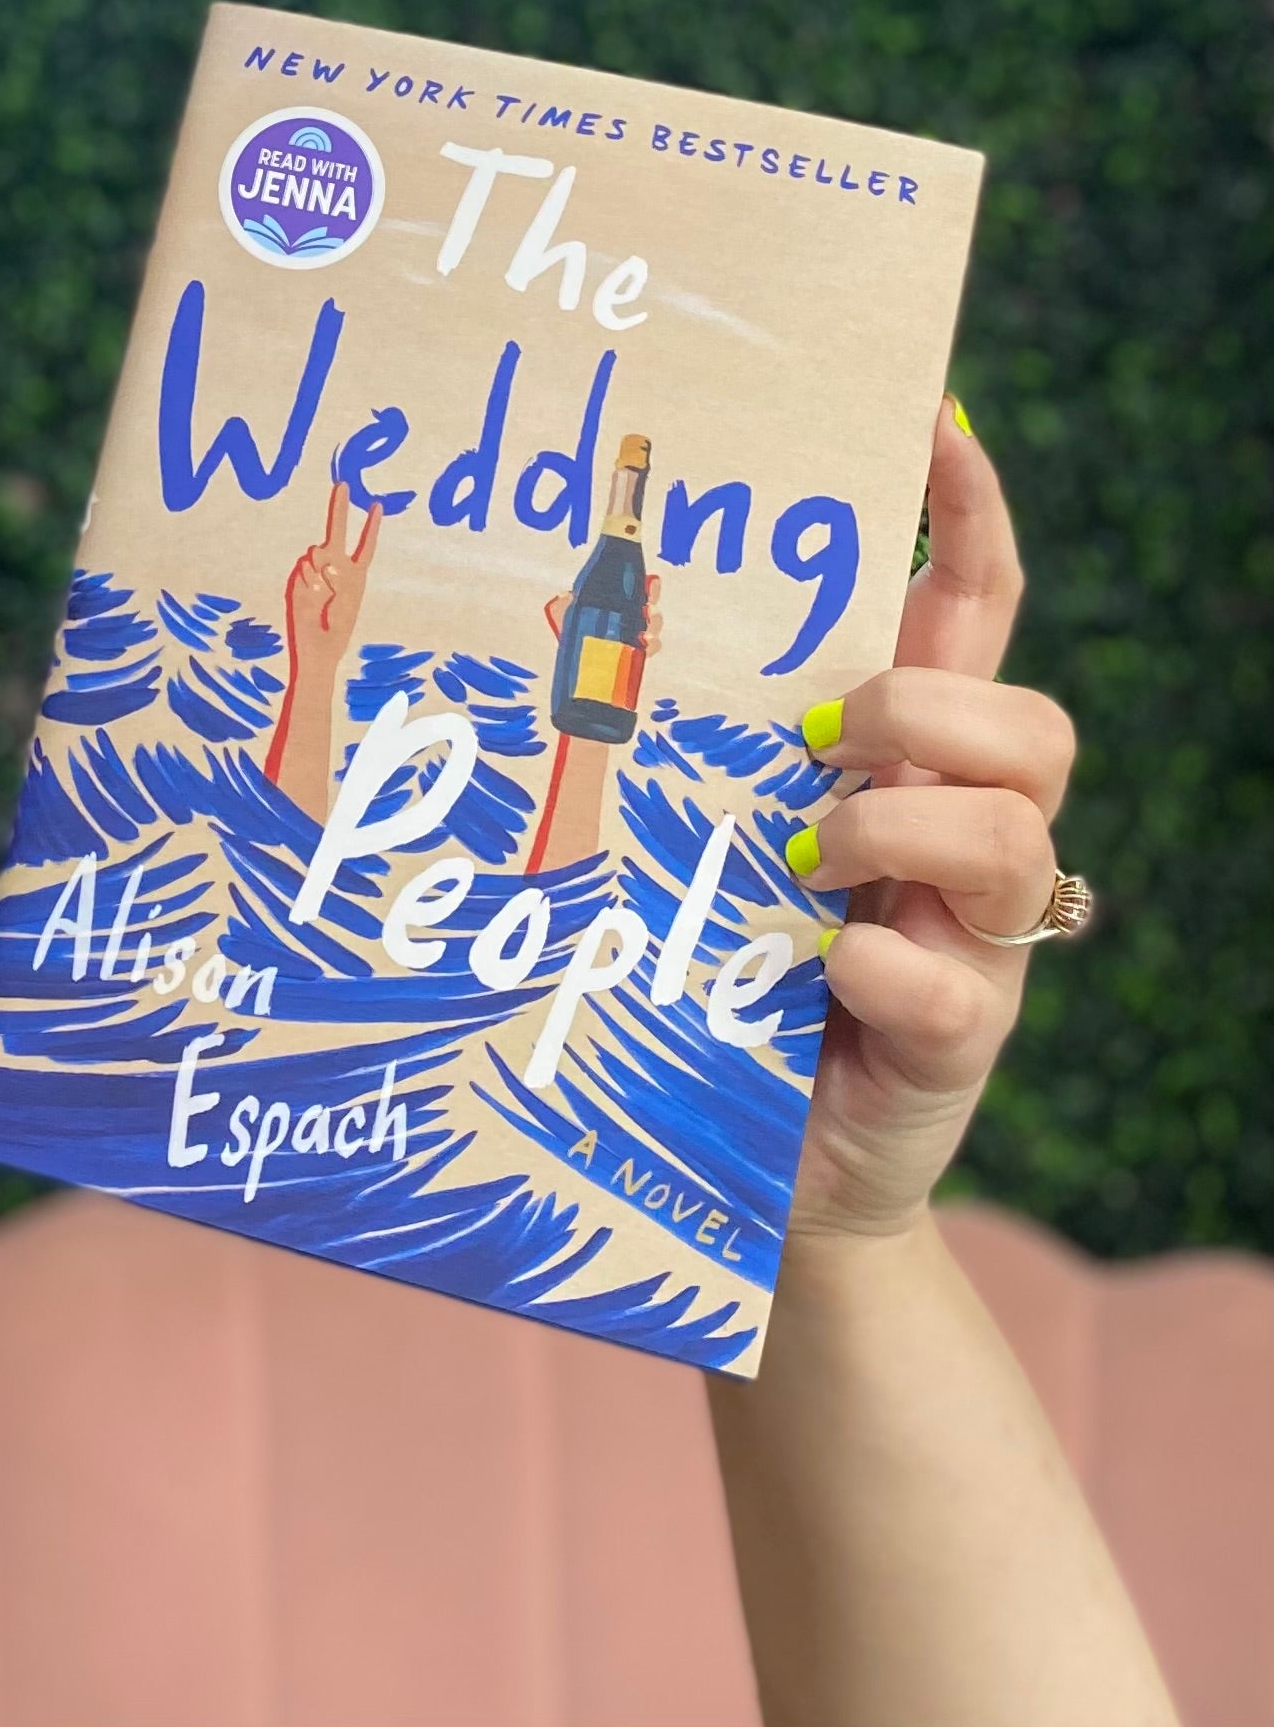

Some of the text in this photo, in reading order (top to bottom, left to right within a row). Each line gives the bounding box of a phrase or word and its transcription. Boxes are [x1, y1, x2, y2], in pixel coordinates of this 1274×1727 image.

[237, 168, 357, 221] JENNA
[244, 46, 919, 205] NEW YORK TIMES BESTSELLER
[258, 148, 358, 183] READ WITH
[437, 141, 650, 331] The
[32, 851, 279, 1017] Alison
[289, 690, 794, 1089] People
[167, 1033, 409, 1204] Espach
[566, 1129, 742, 1262] A NOVEL
